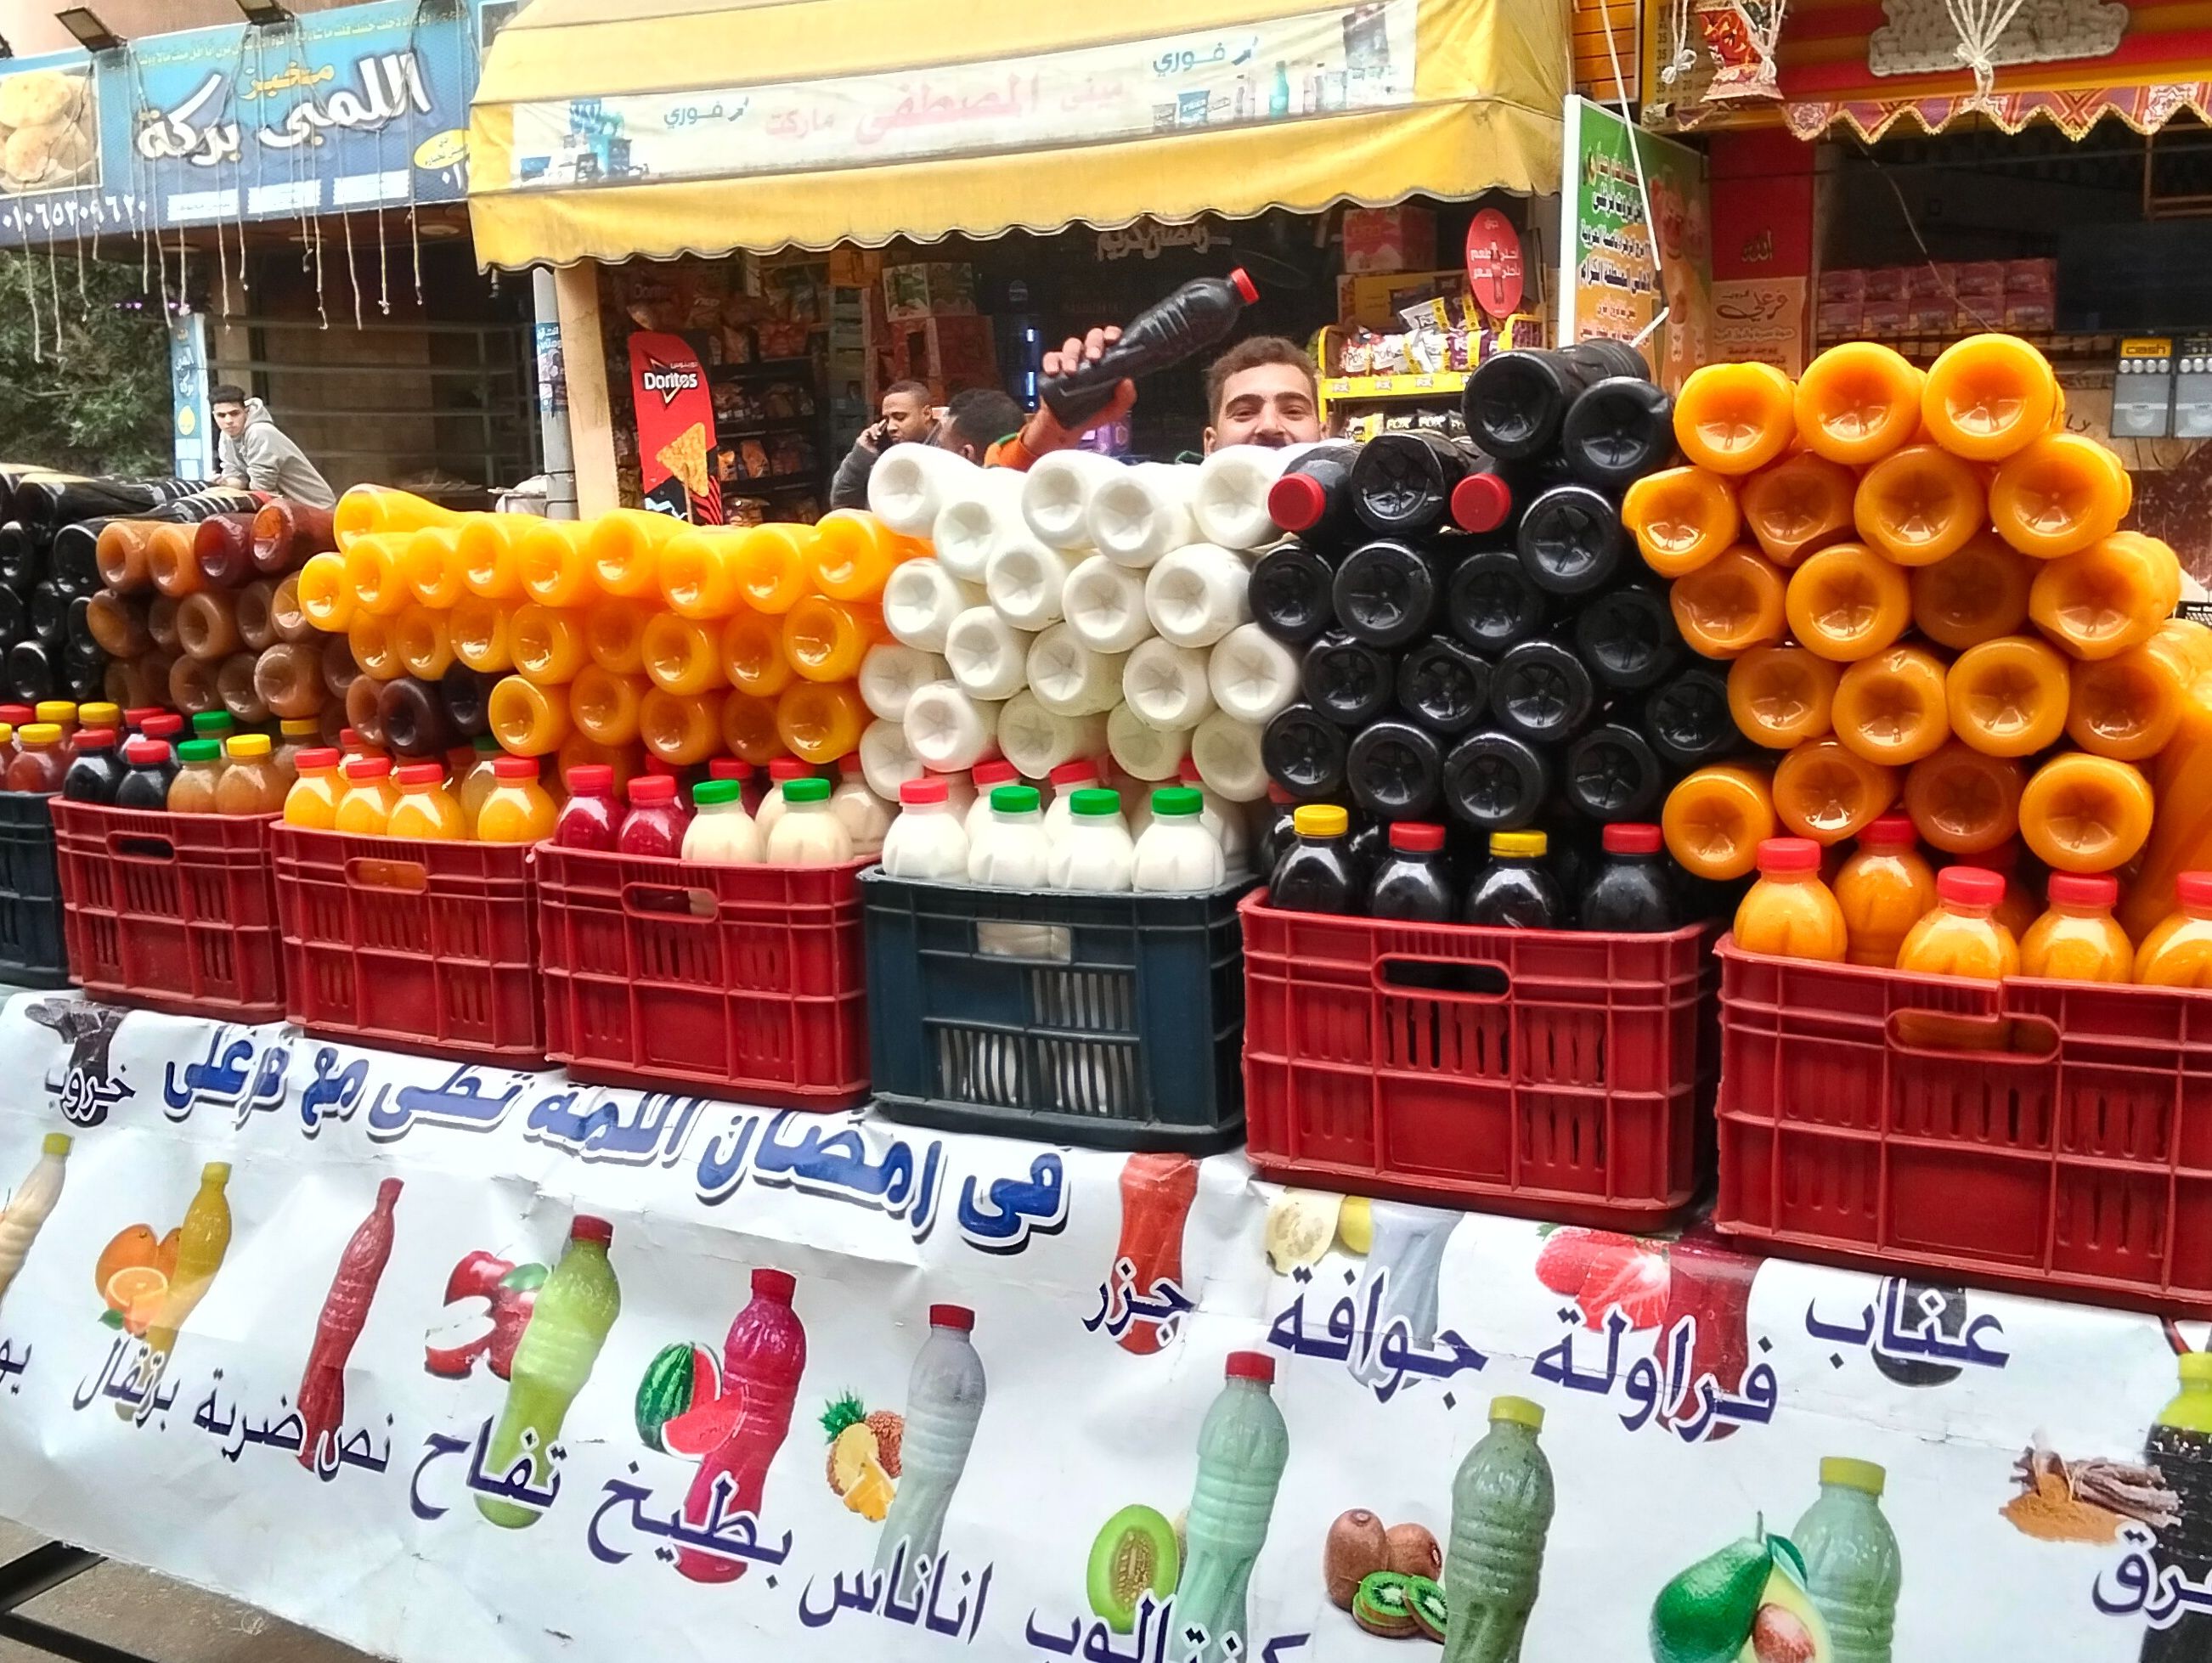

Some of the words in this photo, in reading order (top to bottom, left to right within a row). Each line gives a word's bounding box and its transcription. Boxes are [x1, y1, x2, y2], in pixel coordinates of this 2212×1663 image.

[239, 61, 336, 101] مخبز
[1153, 41, 1226, 78] فوري
[137, 73, 241, 166] بركة
[663, 99, 724, 129] فوري
[644, 372, 698, 390] Doritos
[2125, 343, 2166, 355] cash
[44, 1063, 137, 1115] خروب
[163, 1024, 295, 1119] فرغلى
[301, 1046, 370, 1127] مع
[368, 1063, 534, 1130] تحلى
[697, 1108, 943, 1230] رمضان
[1081, 1262, 1195, 1346] جزر
[1267, 1266, 1489, 1412] جوافة
[1804, 1276, 2010, 1371] عناب
[72, 1336, 180, 1431] برتقال
[1530, 1305, 1780, 1444] فراولة
[409, 1416, 568, 1519] تفاح
[587, 1460, 793, 1589] بطيخ
[798, 1541, 995, 1645] اناناس
[2091, 1529, 2212, 1622] رق
